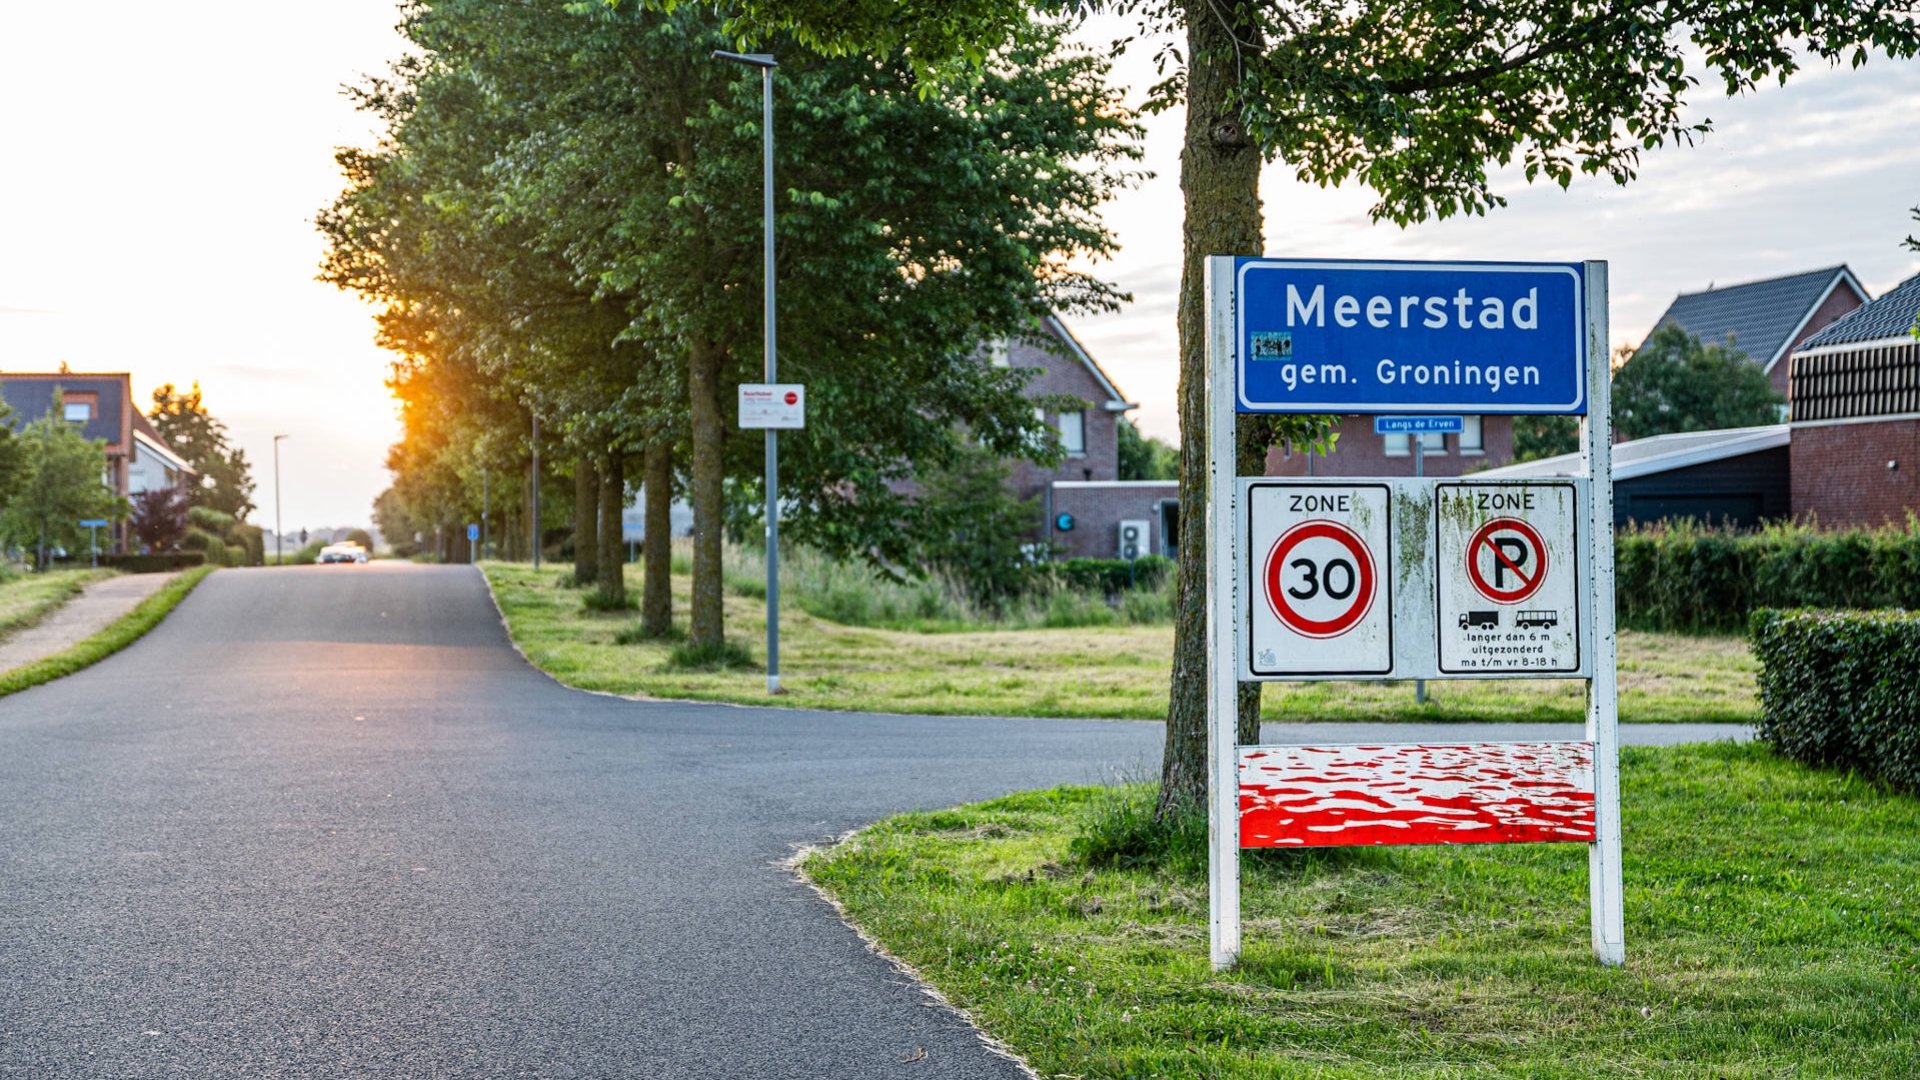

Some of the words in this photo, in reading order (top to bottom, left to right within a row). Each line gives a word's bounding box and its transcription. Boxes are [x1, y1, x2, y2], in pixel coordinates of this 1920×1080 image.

[1286, 284, 1538, 330] Meerstad
[1281, 364, 1357, 391] gem.
[1376, 359, 1540, 393] Groningen
[1386, 420, 1412, 431] Langs
[1415, 420, 1425, 428] de
[1429, 420, 1454, 429] Erven
[1289, 495, 1350, 513] ZONE
[1476, 493, 1535, 510] ZONE
[1494, 537, 1528, 588] P
[1287, 558, 1356, 600] 30
[1467, 633, 1502, 644] langer
[1505, 633, 1526, 642] dan
[1529, 633, 1537, 641] 6
[1472, 645, 1543, 656] uitgezonderd
[1461, 659, 1477, 667] ma
[1481, 657, 1502, 667] t/m
[1506, 659, 1518, 667] vr
[1522, 657, 1547, 667] 8-18
[1551, 657, 1558, 667] h
